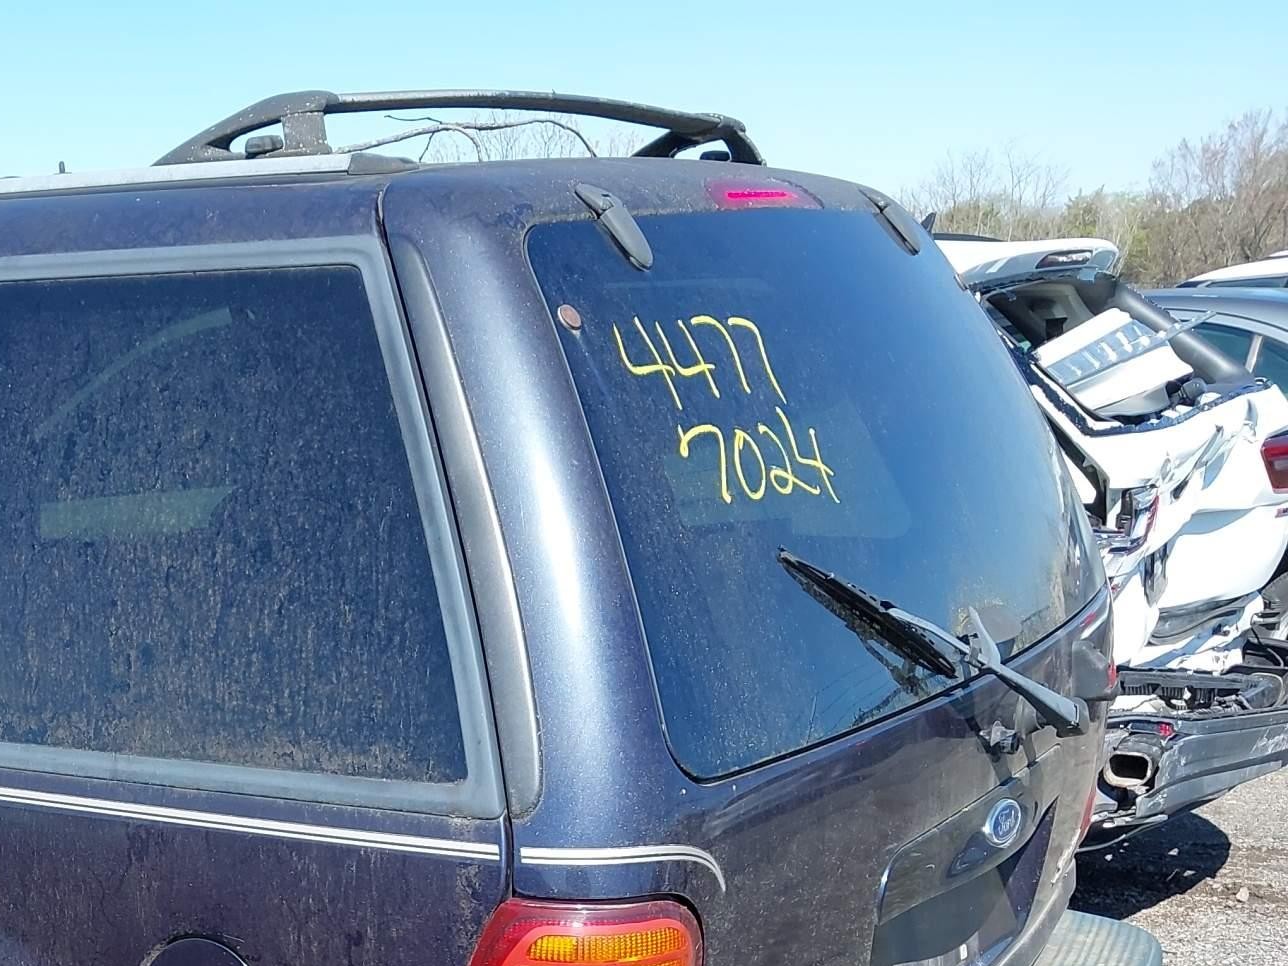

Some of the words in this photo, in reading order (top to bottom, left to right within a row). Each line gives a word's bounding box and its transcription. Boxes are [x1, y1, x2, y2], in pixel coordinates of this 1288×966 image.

[613, 315, 787, 411] 4477
[677, 406, 841, 504] 7024
[997, 808, 1016, 836] Ford
